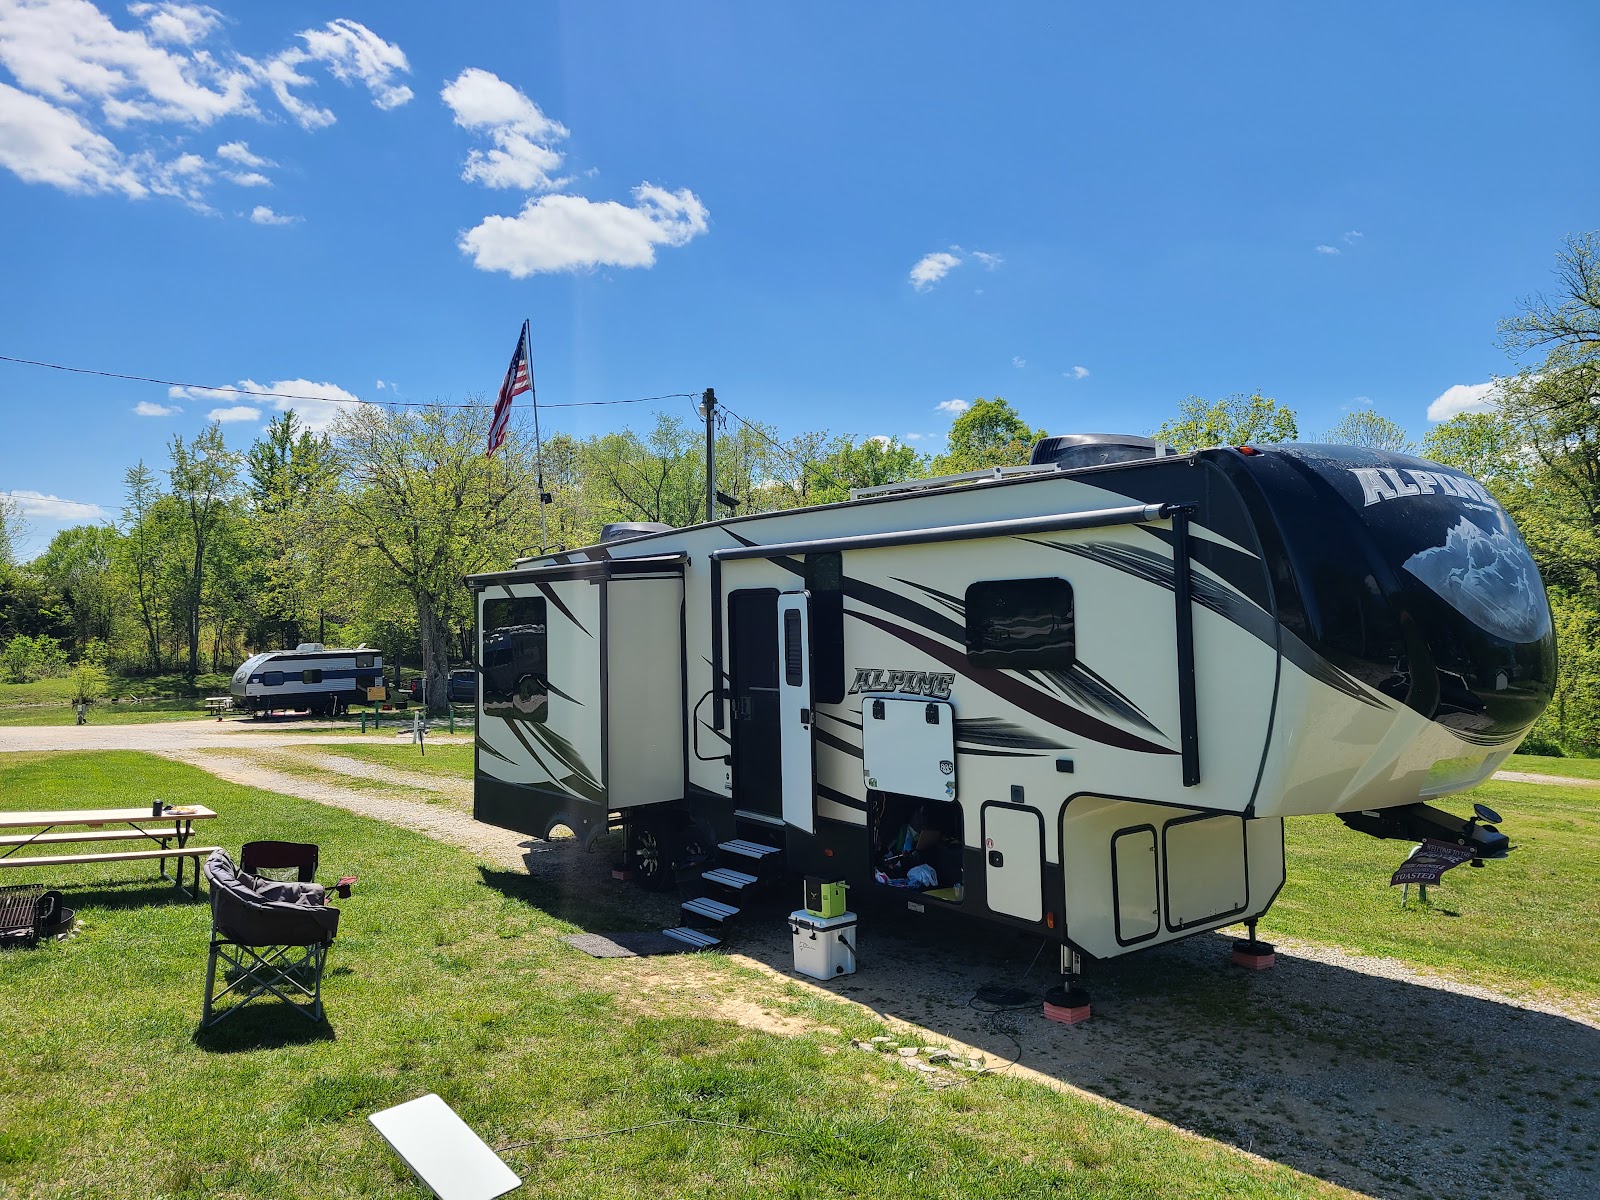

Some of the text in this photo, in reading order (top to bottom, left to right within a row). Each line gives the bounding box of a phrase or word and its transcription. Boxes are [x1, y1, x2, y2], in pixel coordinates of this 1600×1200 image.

[1347, 468, 1499, 507] ALPINE
[848, 668, 955, 700] ALPINE
[1395, 873, 1436, 881] TOASTED
